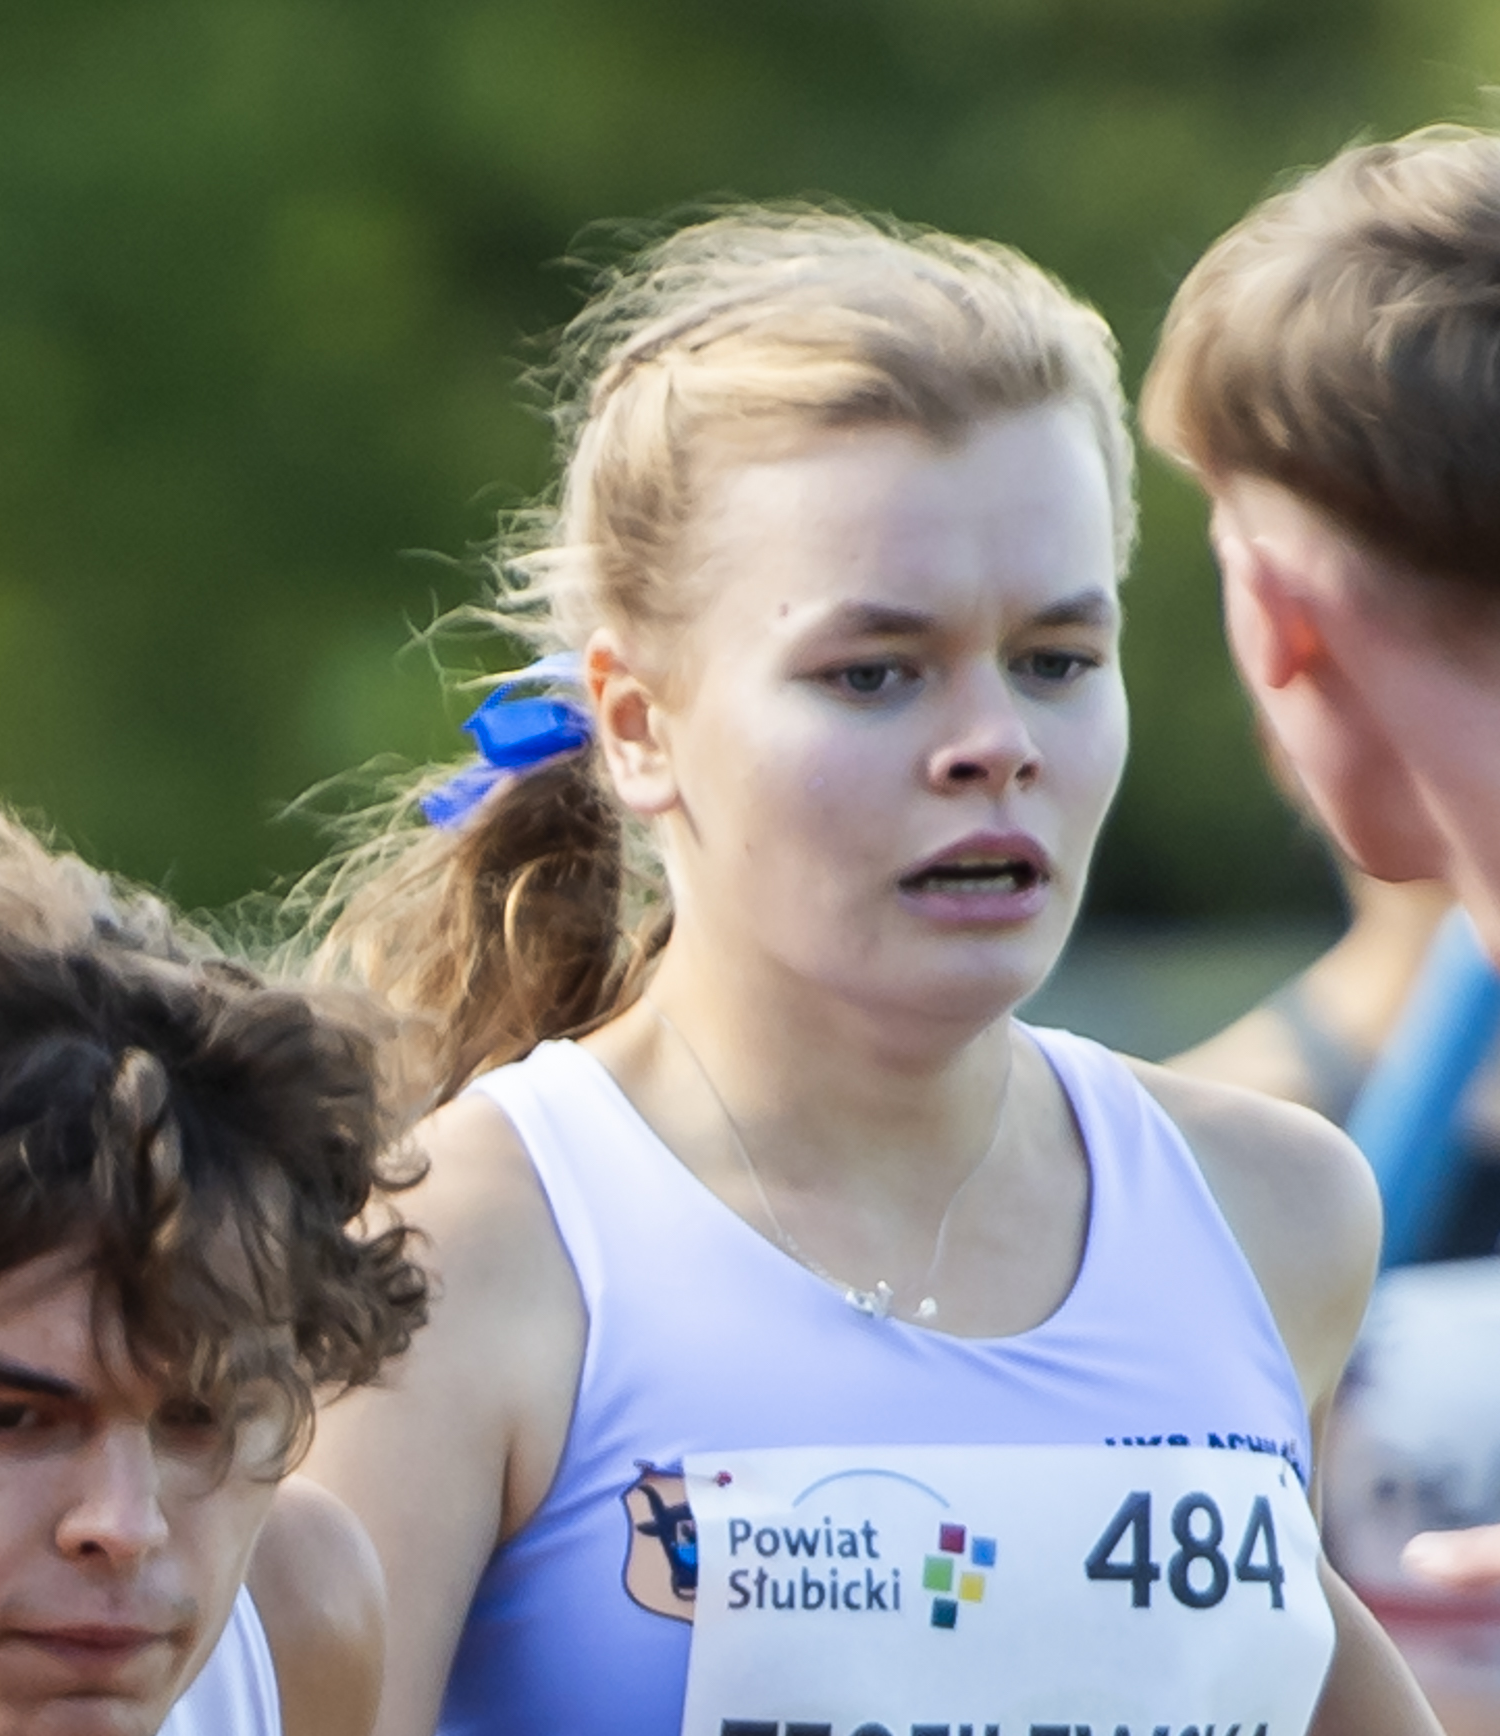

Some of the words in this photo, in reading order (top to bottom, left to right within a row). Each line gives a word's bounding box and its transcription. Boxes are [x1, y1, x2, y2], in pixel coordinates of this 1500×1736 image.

[728, 1515, 880, 1559] Powiat
[1083, 1489, 1285, 1610] 484
[727, 1565, 901, 1611] Słubicki
